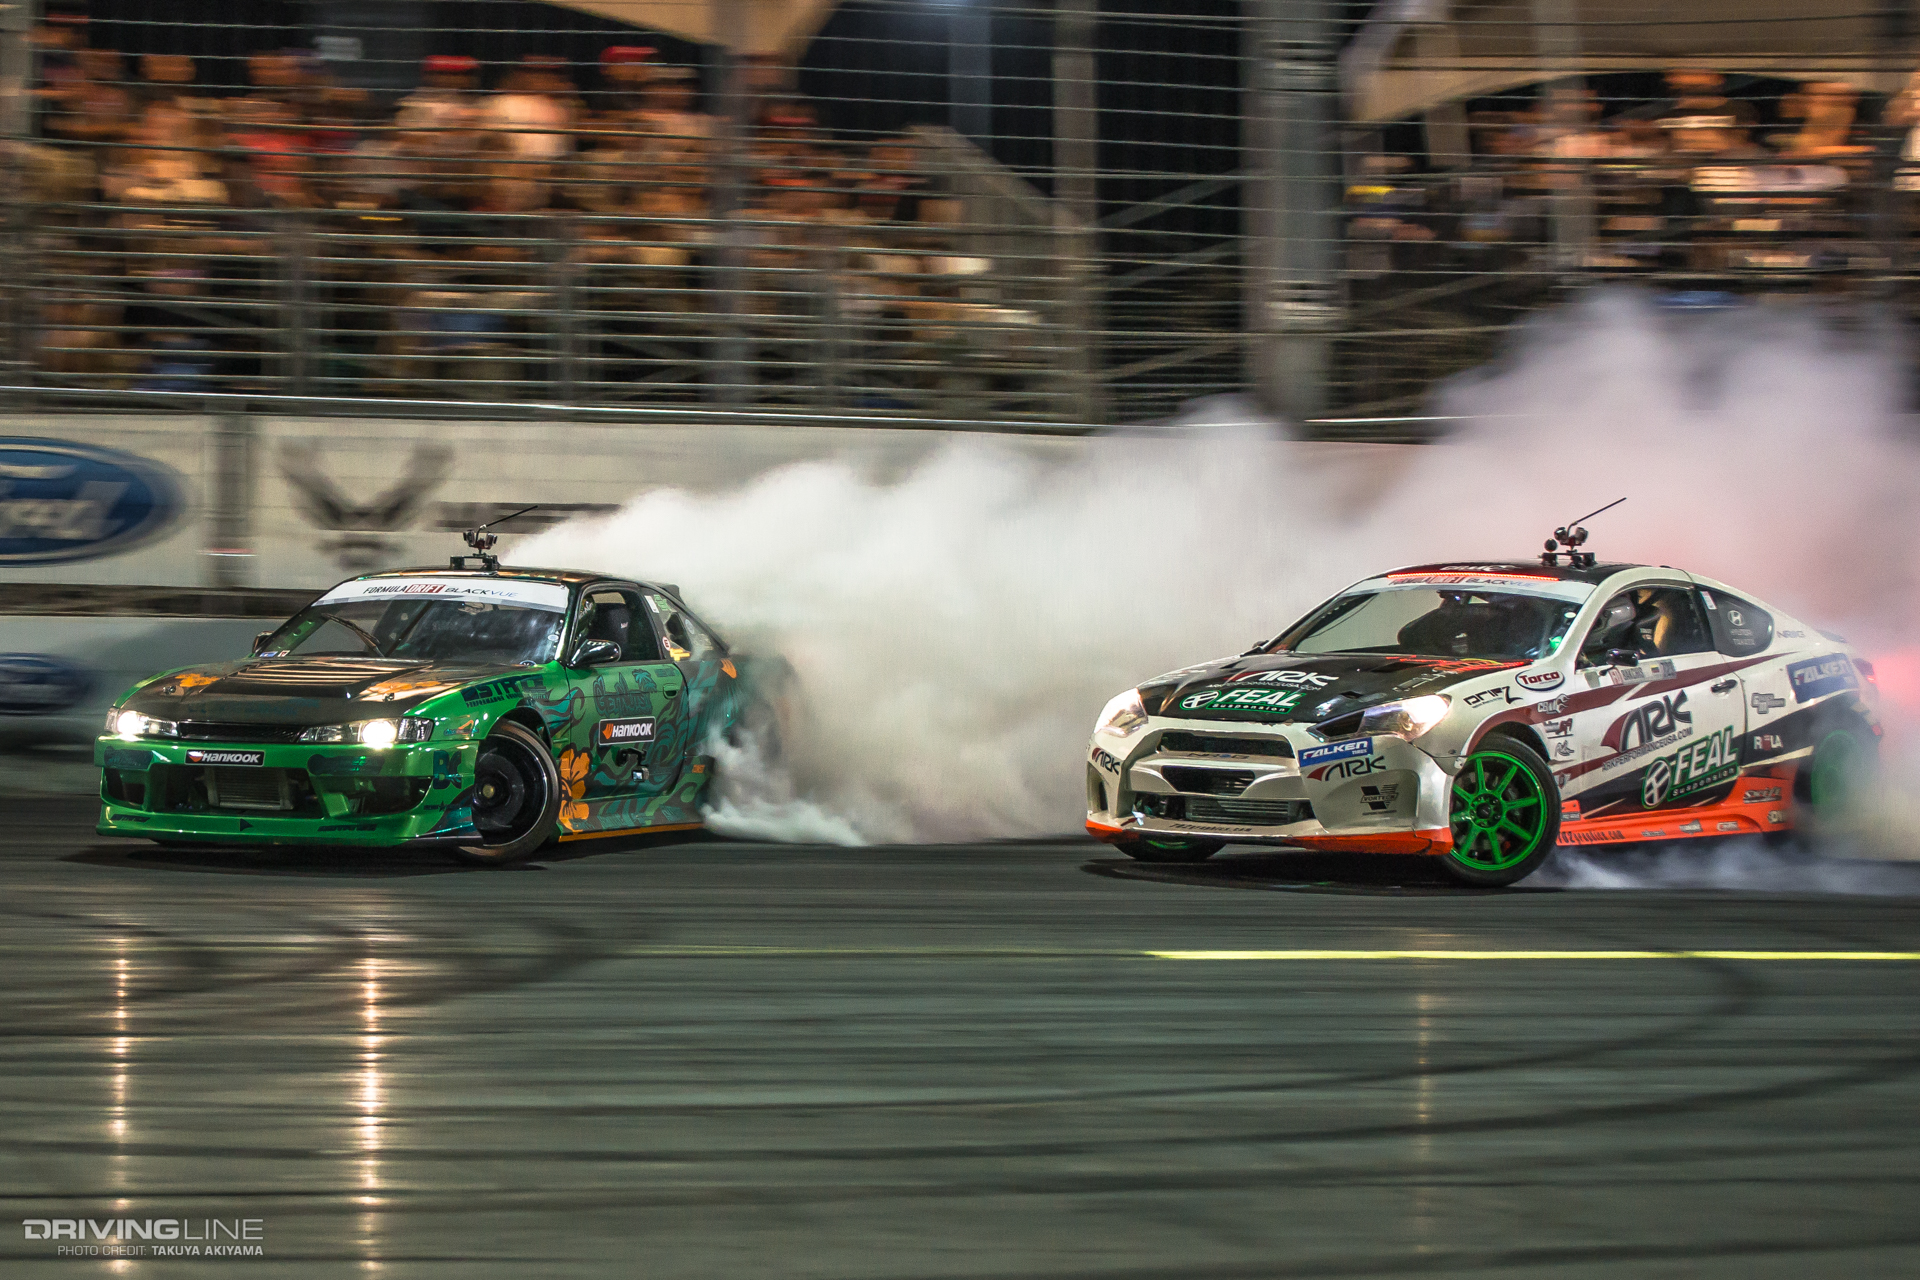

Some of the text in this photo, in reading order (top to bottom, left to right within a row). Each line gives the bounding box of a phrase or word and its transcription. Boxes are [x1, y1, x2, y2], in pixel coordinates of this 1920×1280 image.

[363, 585, 407, 594] FORMULA
[409, 584, 443, 593] DRIFT
[1519, 671, 1560, 684] Torco
[1794, 660, 1850, 685] FALKEN
[1211, 703, 1286, 712] Suspension
[1216, 689, 1301, 706] FEAL
[1617, 689, 1692, 753] ARK
[1303, 741, 1368, 759] FALKEN
[1602, 727, 1693, 772] ARKPERFORMANCEUSA.COM
[1674, 728, 1738, 785] FEAL
[1322, 756, 1386, 781] ARK
[1673, 767, 1735, 796] Suspension
